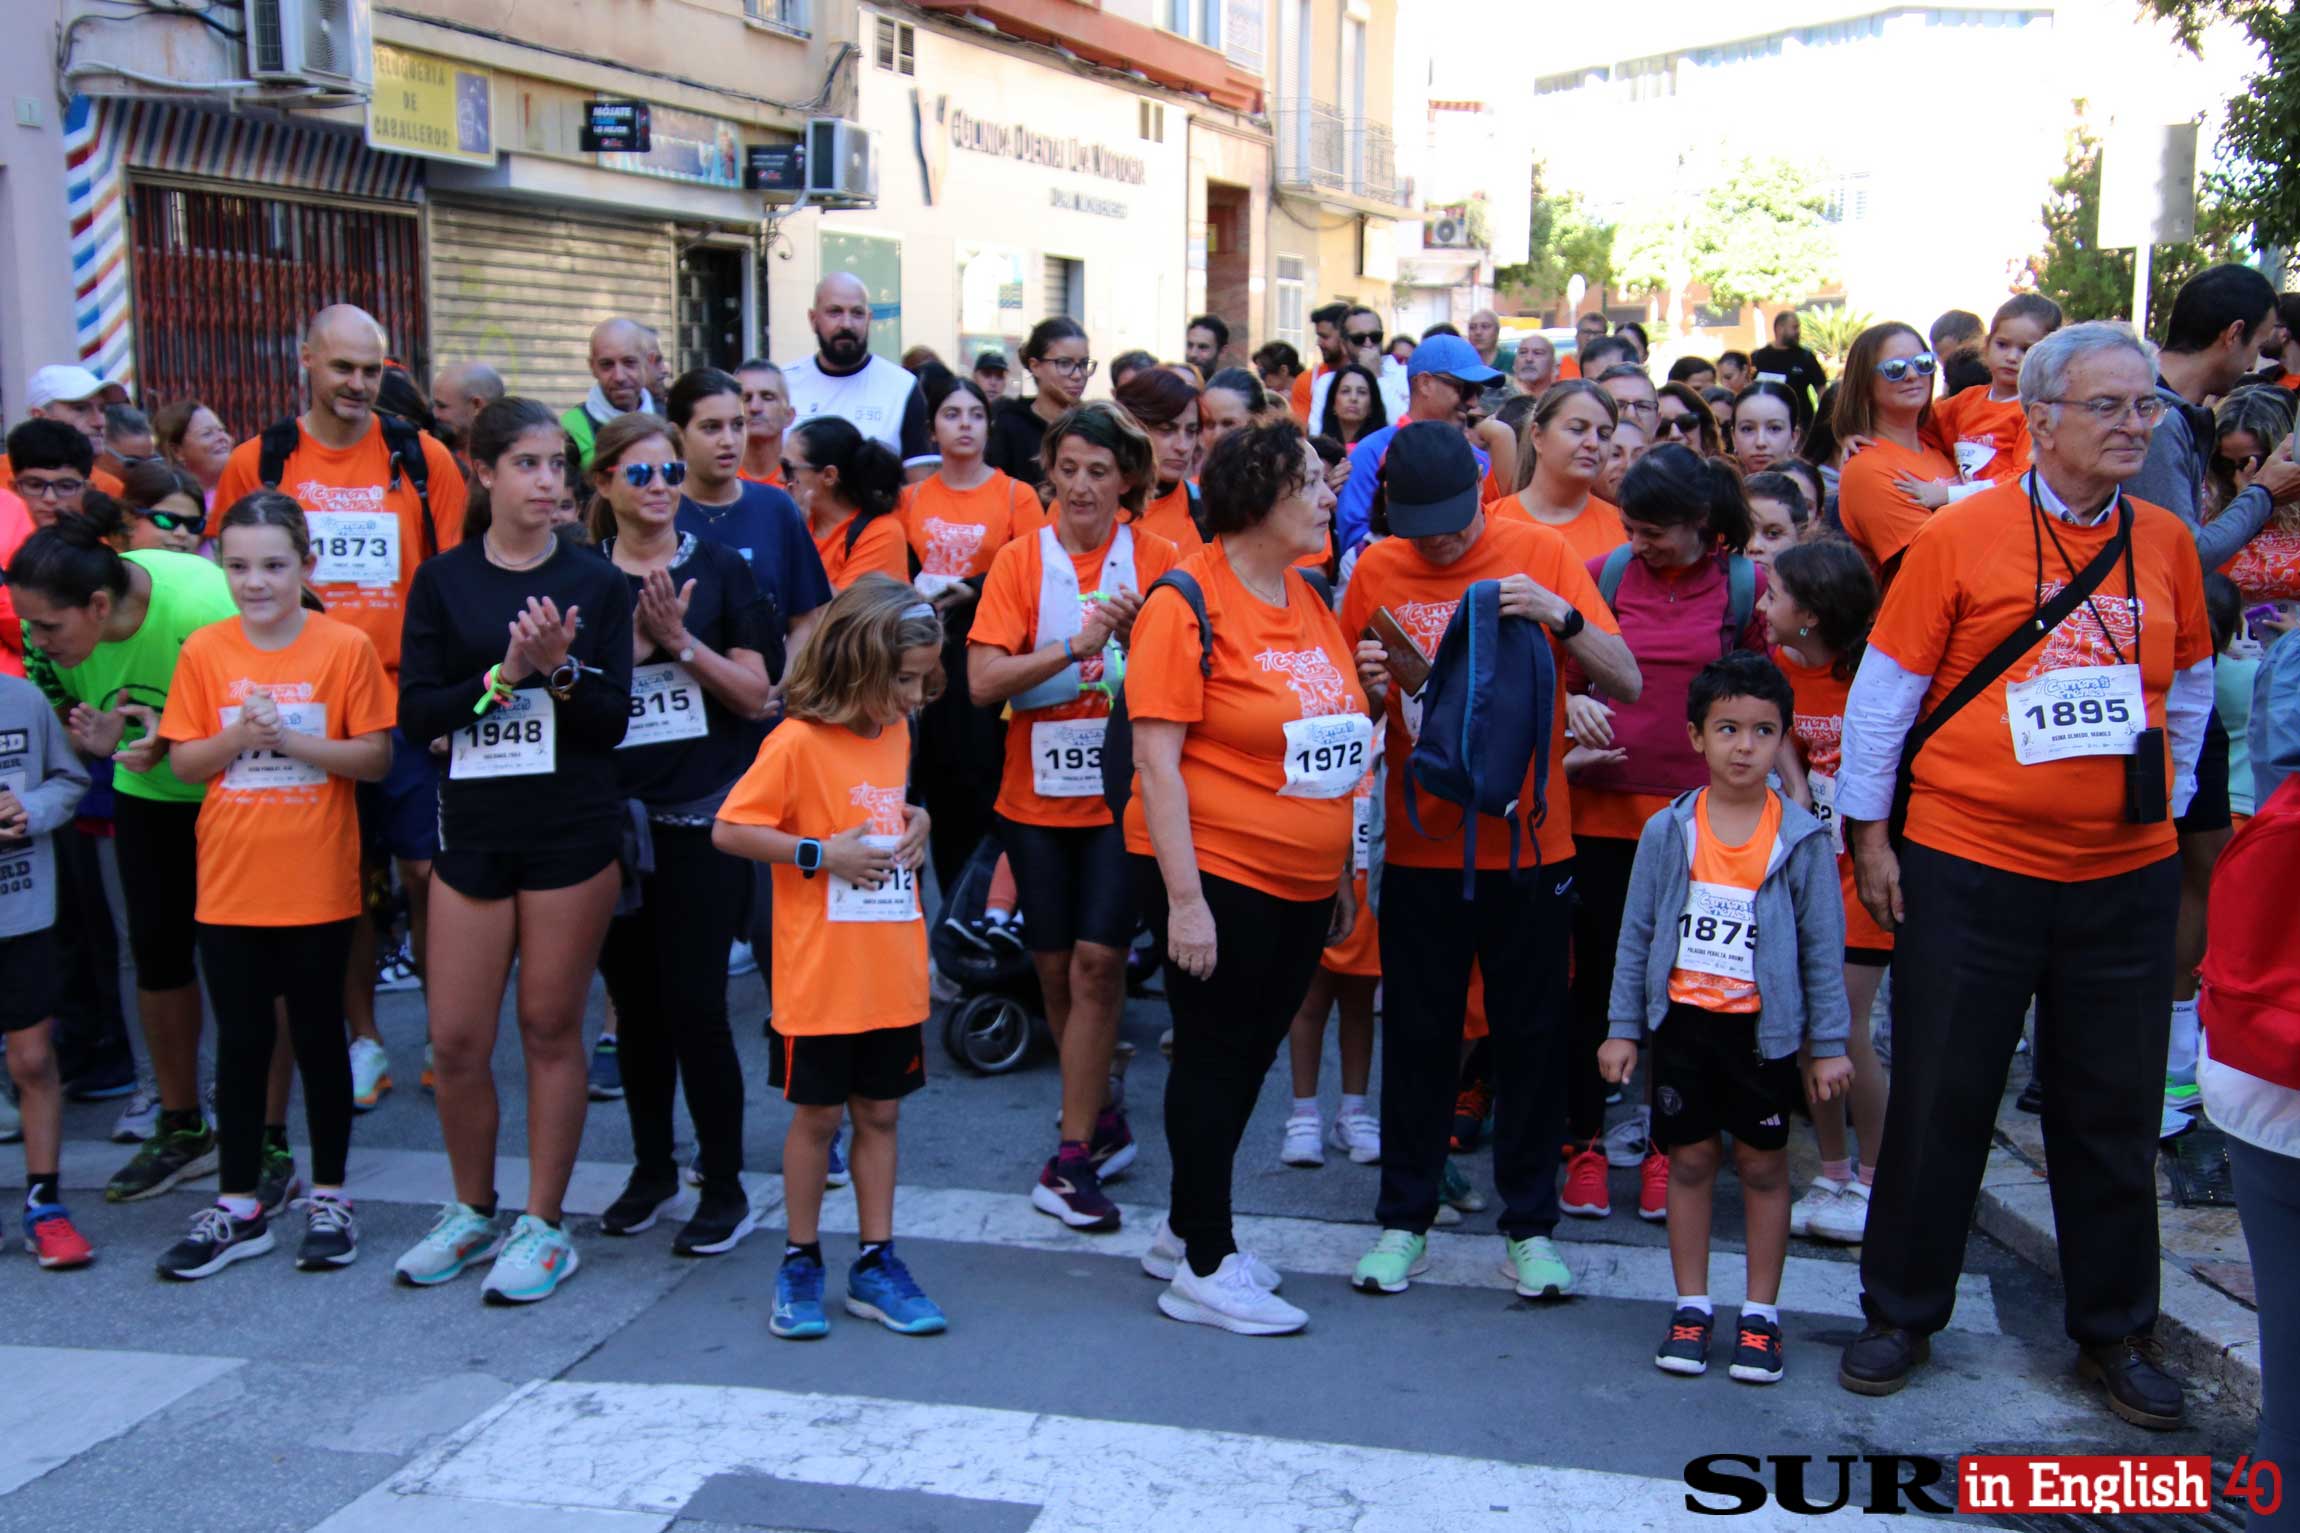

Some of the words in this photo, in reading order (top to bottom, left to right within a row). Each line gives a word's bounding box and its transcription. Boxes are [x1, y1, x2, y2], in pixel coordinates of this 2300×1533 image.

[402, 90, 417, 111] DE
[373, 115, 449, 148] CABALLEROS
[311, 537, 388, 558] 1873
[629, 688, 690, 718] 815
[2025, 698, 2130, 731] 1895
[465, 720, 542, 748] 1948
[1045, 746, 1103, 770] 193
[1296, 740, 1363, 773] 1972
[1679, 913, 1758, 950] 1875
